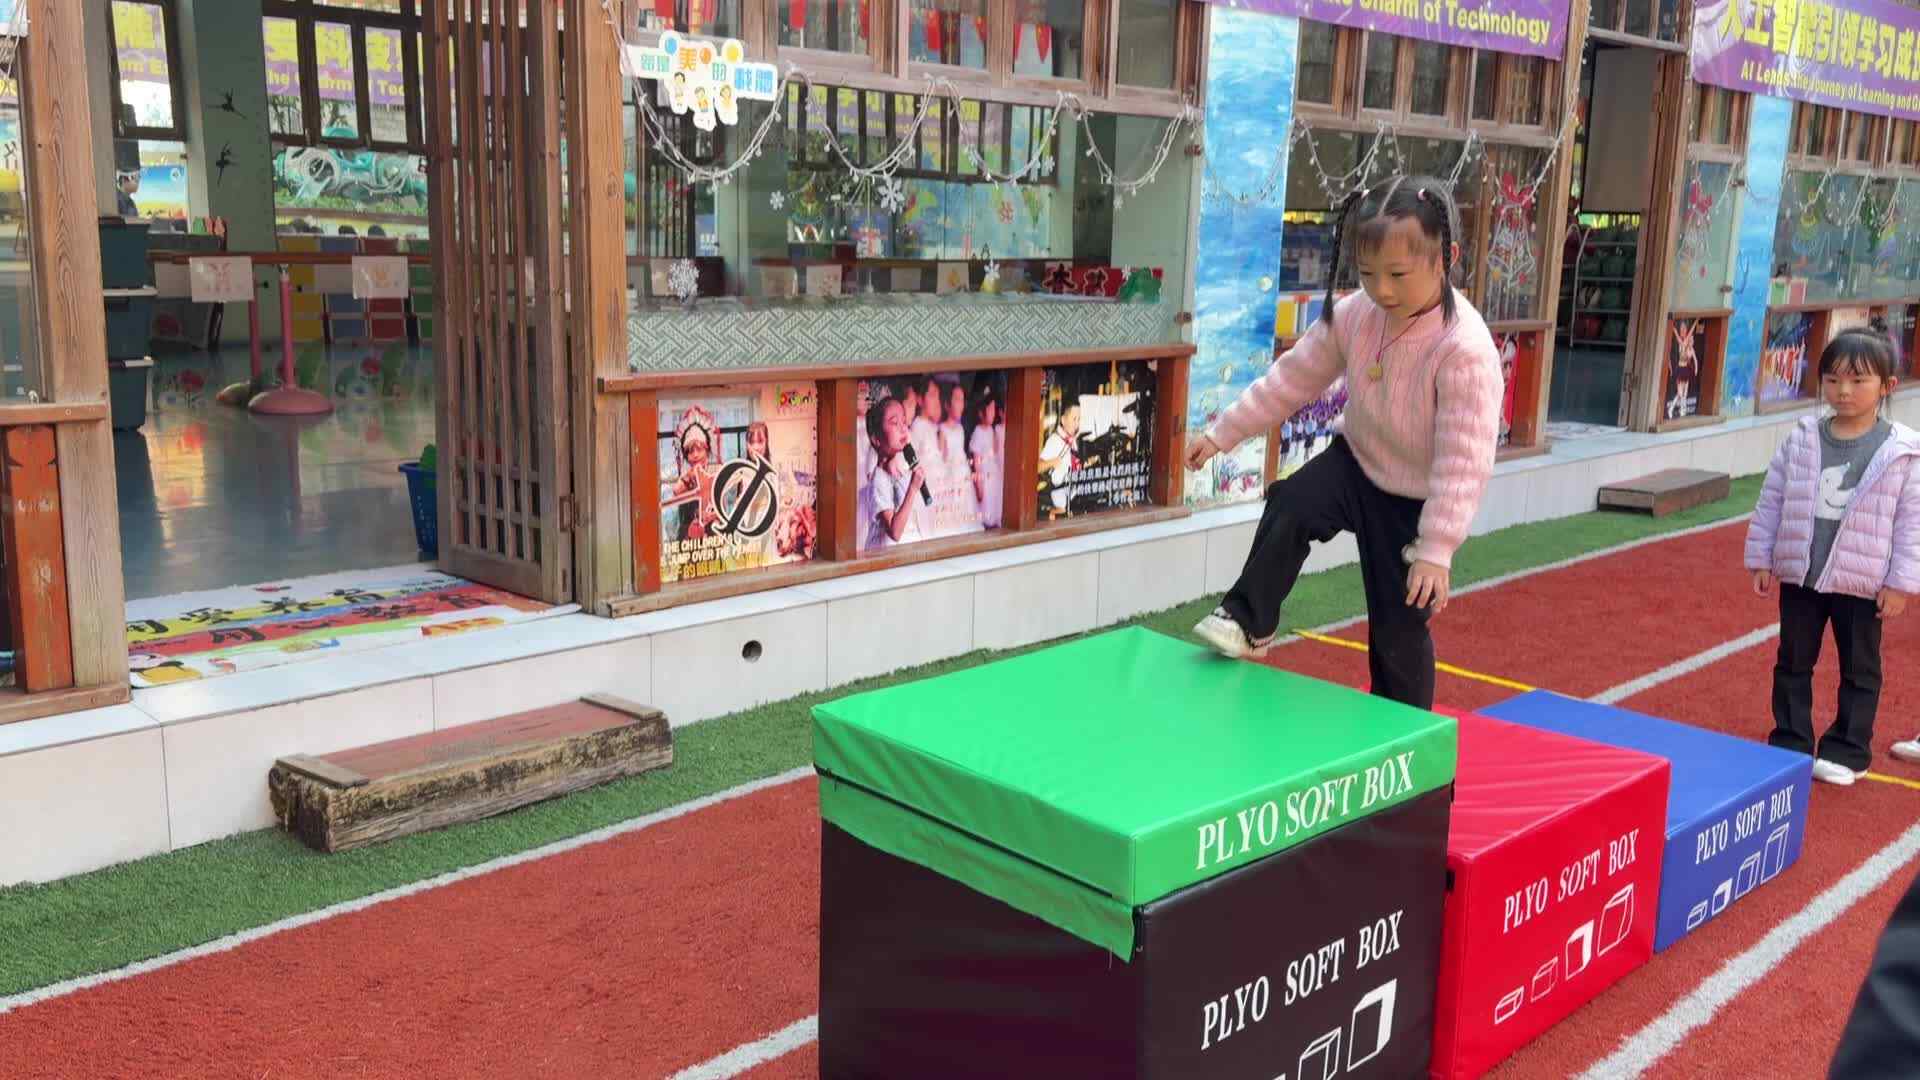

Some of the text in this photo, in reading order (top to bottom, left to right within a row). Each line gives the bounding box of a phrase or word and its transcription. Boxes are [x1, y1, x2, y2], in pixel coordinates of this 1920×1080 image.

[1423, 1, 1442, 23] of
[1446, 0, 1551, 45] Technology
[1717, 0, 1920, 81] 人工智能引领学习成
[1741, 58, 1754, 80] AI
[1848, 81, 1858, 100] of
[1858, 82, 1895, 111] Learning
[1896, 93, 1912, 112] and
[691, 548, 715, 563] OVER
[1195, 749, 1415, 871] PLYO SOFT BOX
[1695, 784, 1794, 865] PLYO SOFT BOX
[1503, 828, 1640, 935] PLYO SOFT BOX
[1200, 909, 1404, 1051] PLYO SOFT BOX
